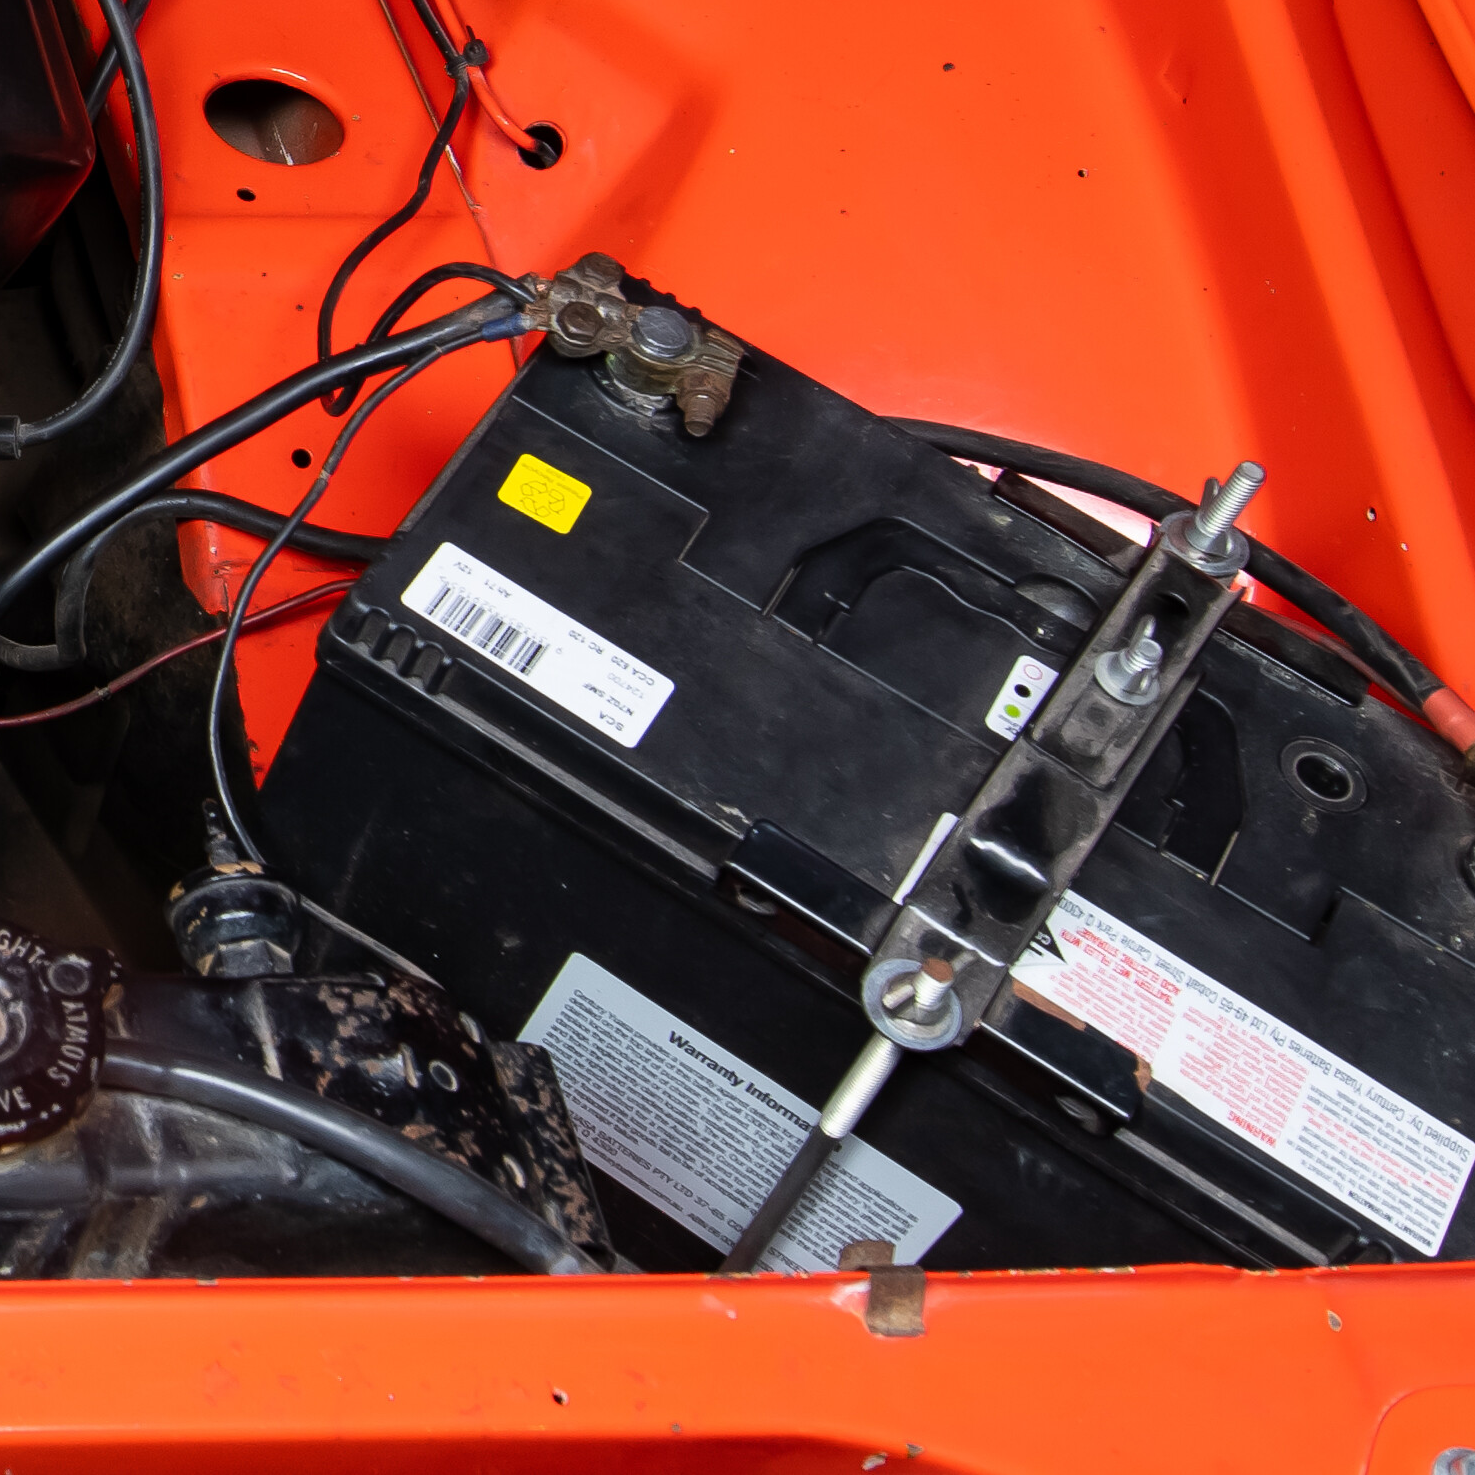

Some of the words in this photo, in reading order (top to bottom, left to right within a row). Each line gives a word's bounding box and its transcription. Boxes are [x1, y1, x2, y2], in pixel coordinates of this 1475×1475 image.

[596, 710, 625, 732] SCA
[1093, 918, 1120, 940] Park
[1184, 975, 1219, 1002] Cobalt
[1248, 1015, 1269, 1034] Ltd
[1267, 1025, 1289, 1045] Pty
[46, 997, 91, 1088] SLOWLY
[1285, 1037, 1334, 1074] Batteries
[664, 1030, 747, 1091] Warranty
[1331, 1067, 1365, 1094] Yuasa
[1362, 1085, 1409, 1122] Century
[1225, 1109, 1278, 1148] WARNING
[1406, 1113, 1426, 1132] by:
[1421, 1123, 1473, 1162] Supplied
[595, 1128, 654, 1171] BATTERIES
[650, 1166, 674, 1186] PTY
[672, 1180, 694, 1199] LTD
